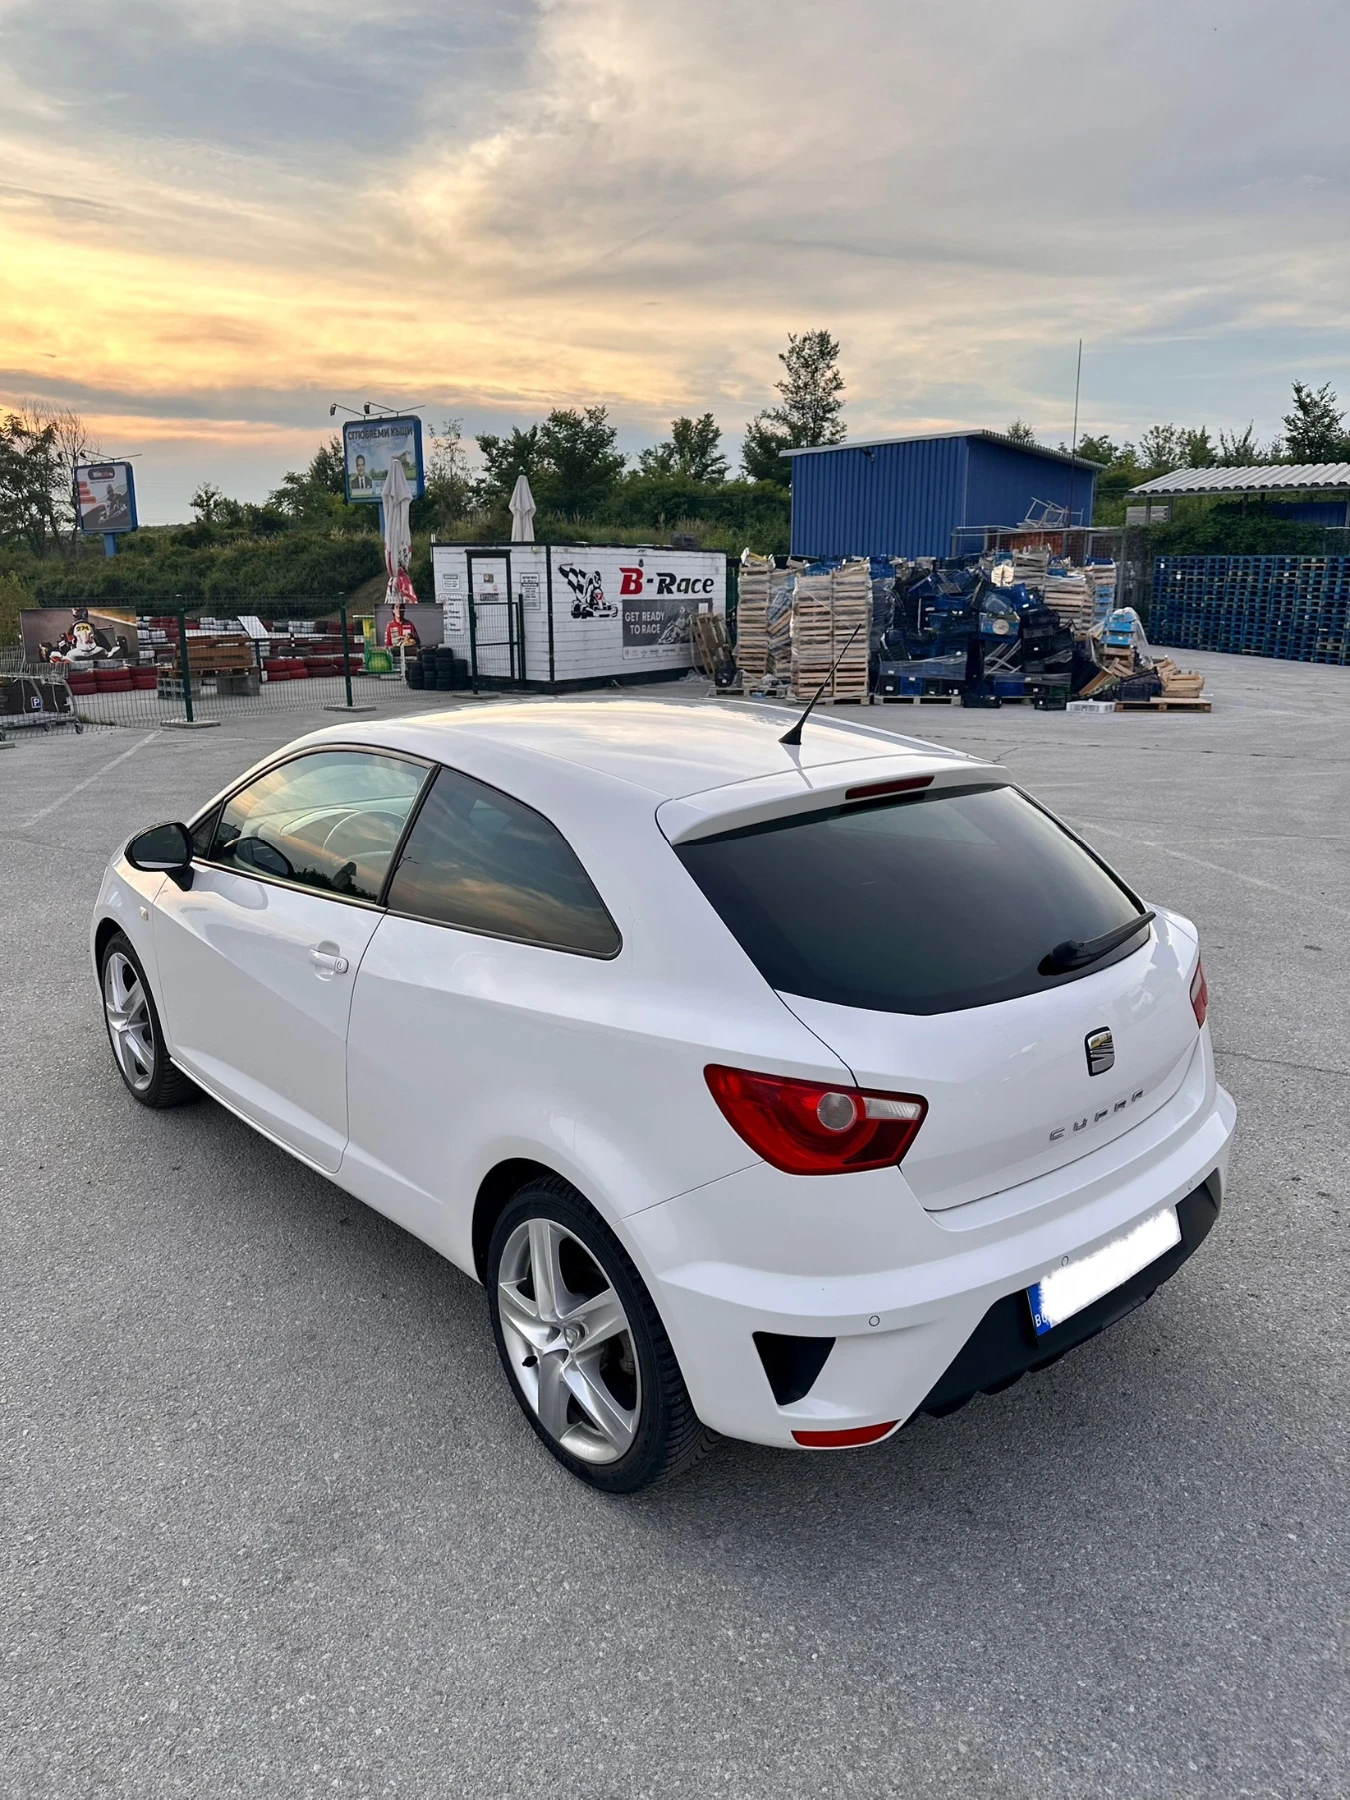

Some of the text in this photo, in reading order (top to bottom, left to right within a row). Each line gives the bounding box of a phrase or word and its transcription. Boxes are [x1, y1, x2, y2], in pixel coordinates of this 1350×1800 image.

[391, 426, 413, 438] КЪЩИ
[625, 611, 665, 622] GET READY
[630, 624, 661, 635] TO RACE
[33, 698, 40, 706] P
[1049, 1087, 1144, 1141] CUPRA
